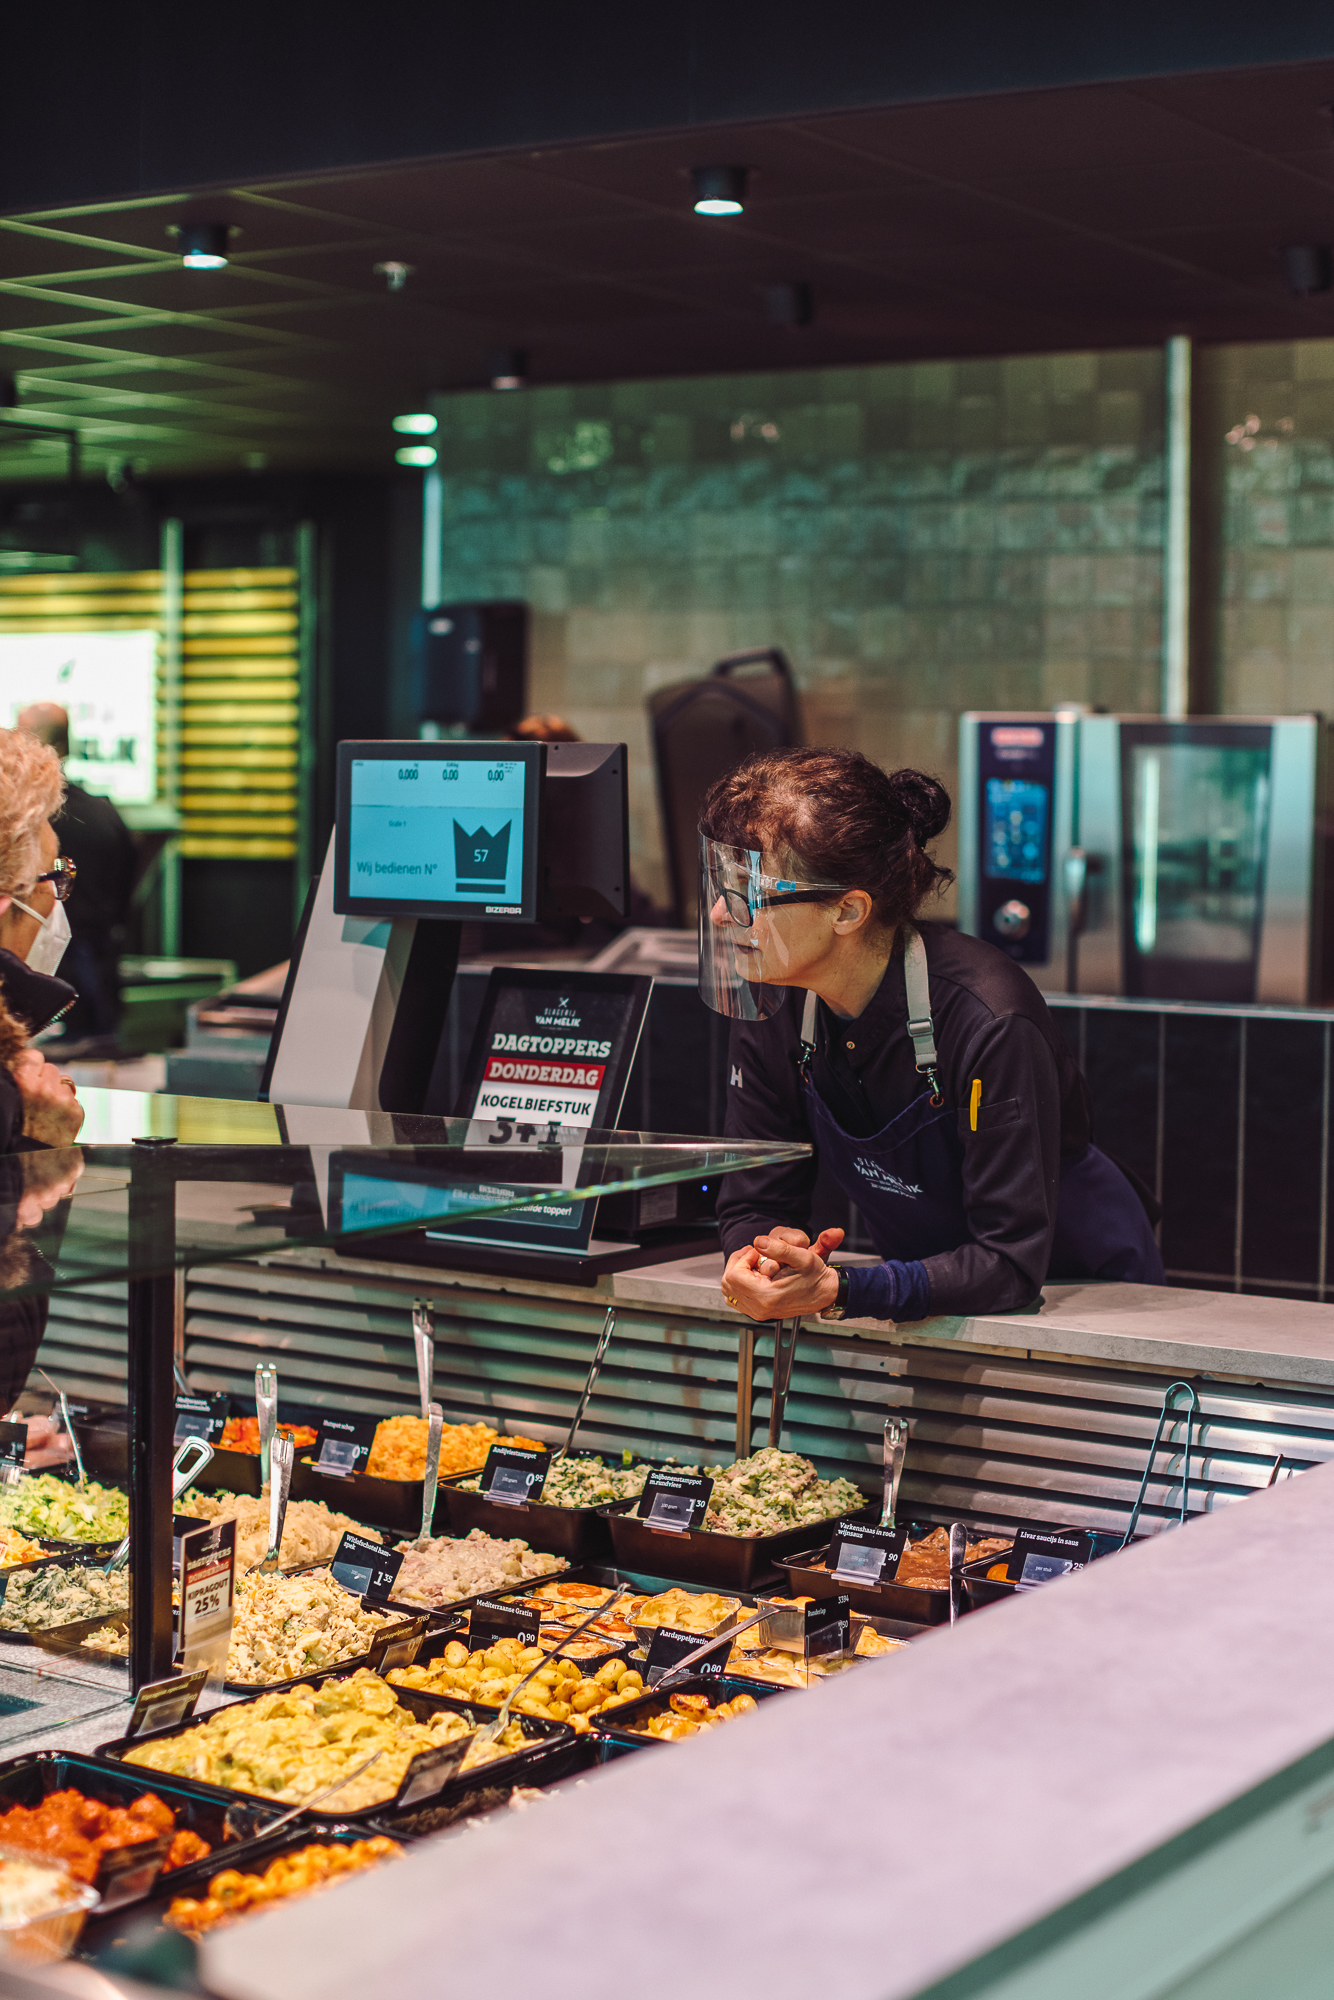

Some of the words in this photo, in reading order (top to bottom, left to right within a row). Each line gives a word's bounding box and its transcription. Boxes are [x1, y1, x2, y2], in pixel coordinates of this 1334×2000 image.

[473, 849, 489, 863] 57
[356, 861, 373, 877] Wij
[374, 862, 422, 875] bedienen
[485, 906, 522, 915] BIZERBA
[535, 1015, 553, 1026] VAN
[553, 1017, 582, 1028] MELIK
[491, 1032, 612, 1058] DAGTOPPERS
[488, 1061, 599, 1086] DONDERDAG
[480, 1093, 592, 1116] KOGELBIEFSTUK
[853, 1162, 880, 1179] VAN
[543, 1205, 572, 1217] topper!
[650, 1472, 702, 1486] Snijbonenstamppot
[838, 1529, 864, 1539] wijnsaus
[840, 1521, 876, 1535] Varkenshaas
[882, 1530, 896, 1538] rode
[1020, 1531, 1036, 1540] Livar
[1064, 1539, 1079, 1547] saus
[187, 1577, 229, 1601] KIPRAGOUT
[194, 1592, 220, 1615] 25%
[476, 1599, 516, 1614] Mediterraanse
[515, 1608, 533, 1618] Gratin
[660, 1629, 709, 1645] Aardappelgratin
